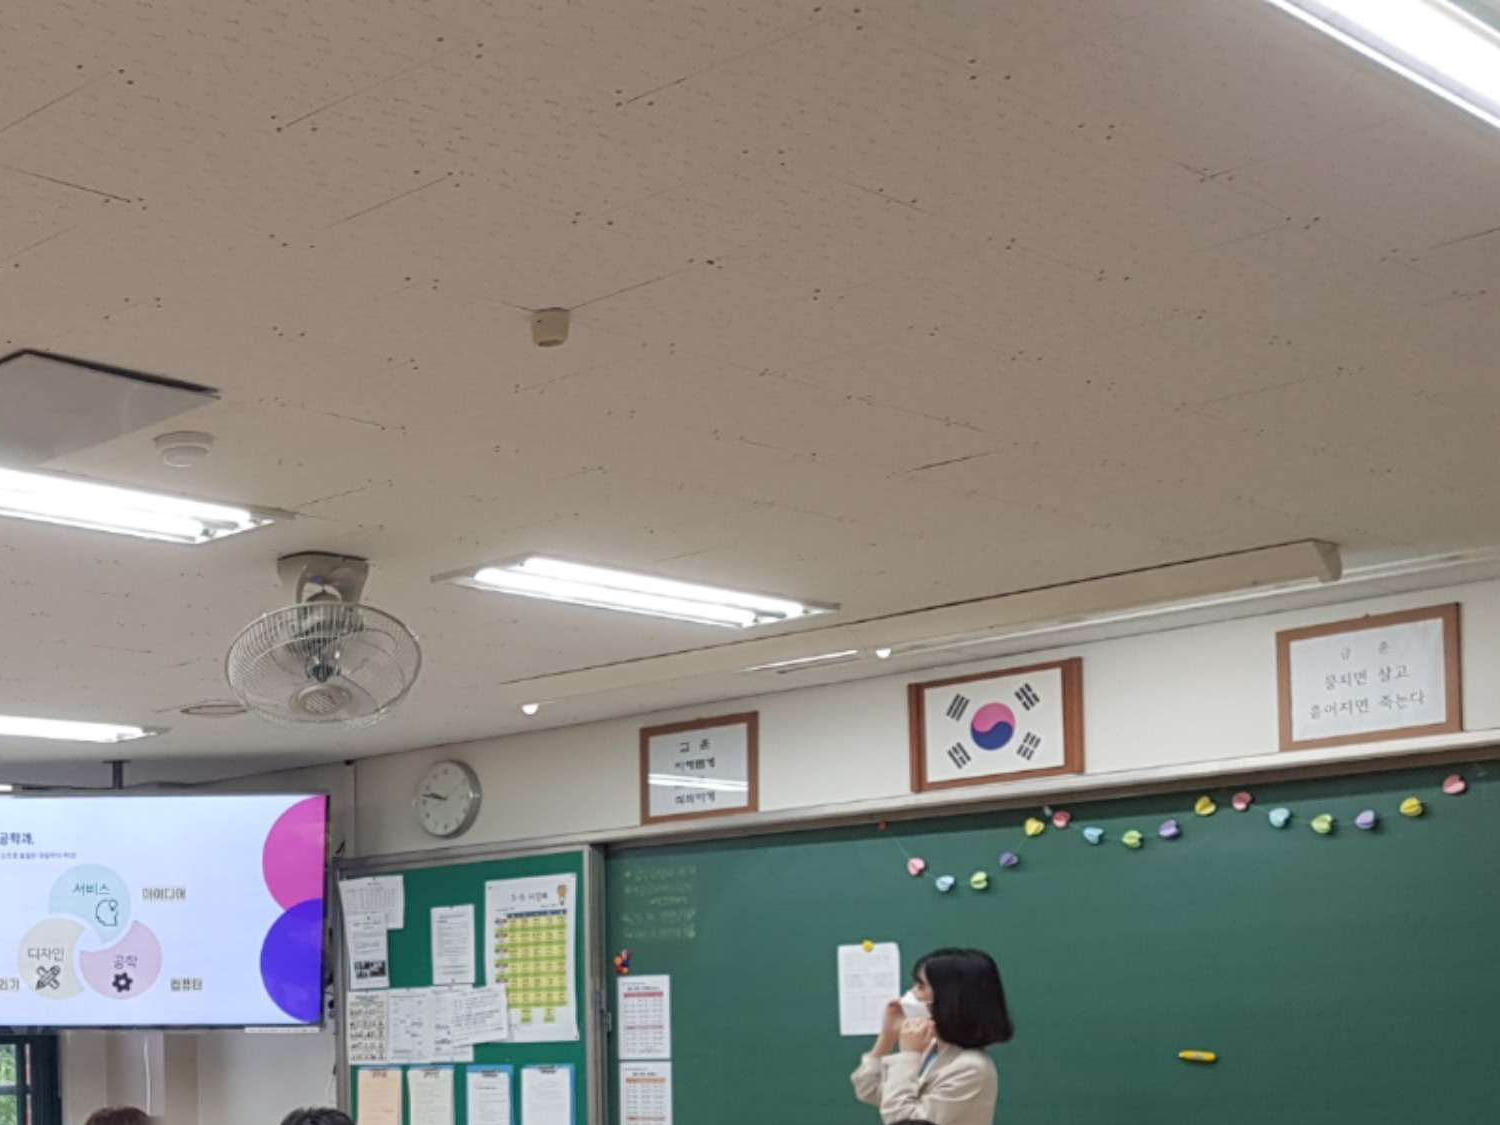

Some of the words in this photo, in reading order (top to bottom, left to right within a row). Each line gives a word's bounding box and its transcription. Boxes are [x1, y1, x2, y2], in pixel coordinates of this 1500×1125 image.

[1323, 668, 1368, 691] 뭉치면
[1377, 664, 1410, 684] 살고
[1309, 696, 1370, 720] 흩어지면
[1377, 689, 1426, 711] 죽는다
[72, 883, 111, 896] 서비스
[27, 947, 65, 962] 디자인
[113, 955, 139, 970] 공학
[170, 978, 203, 991] 컴퓨터
